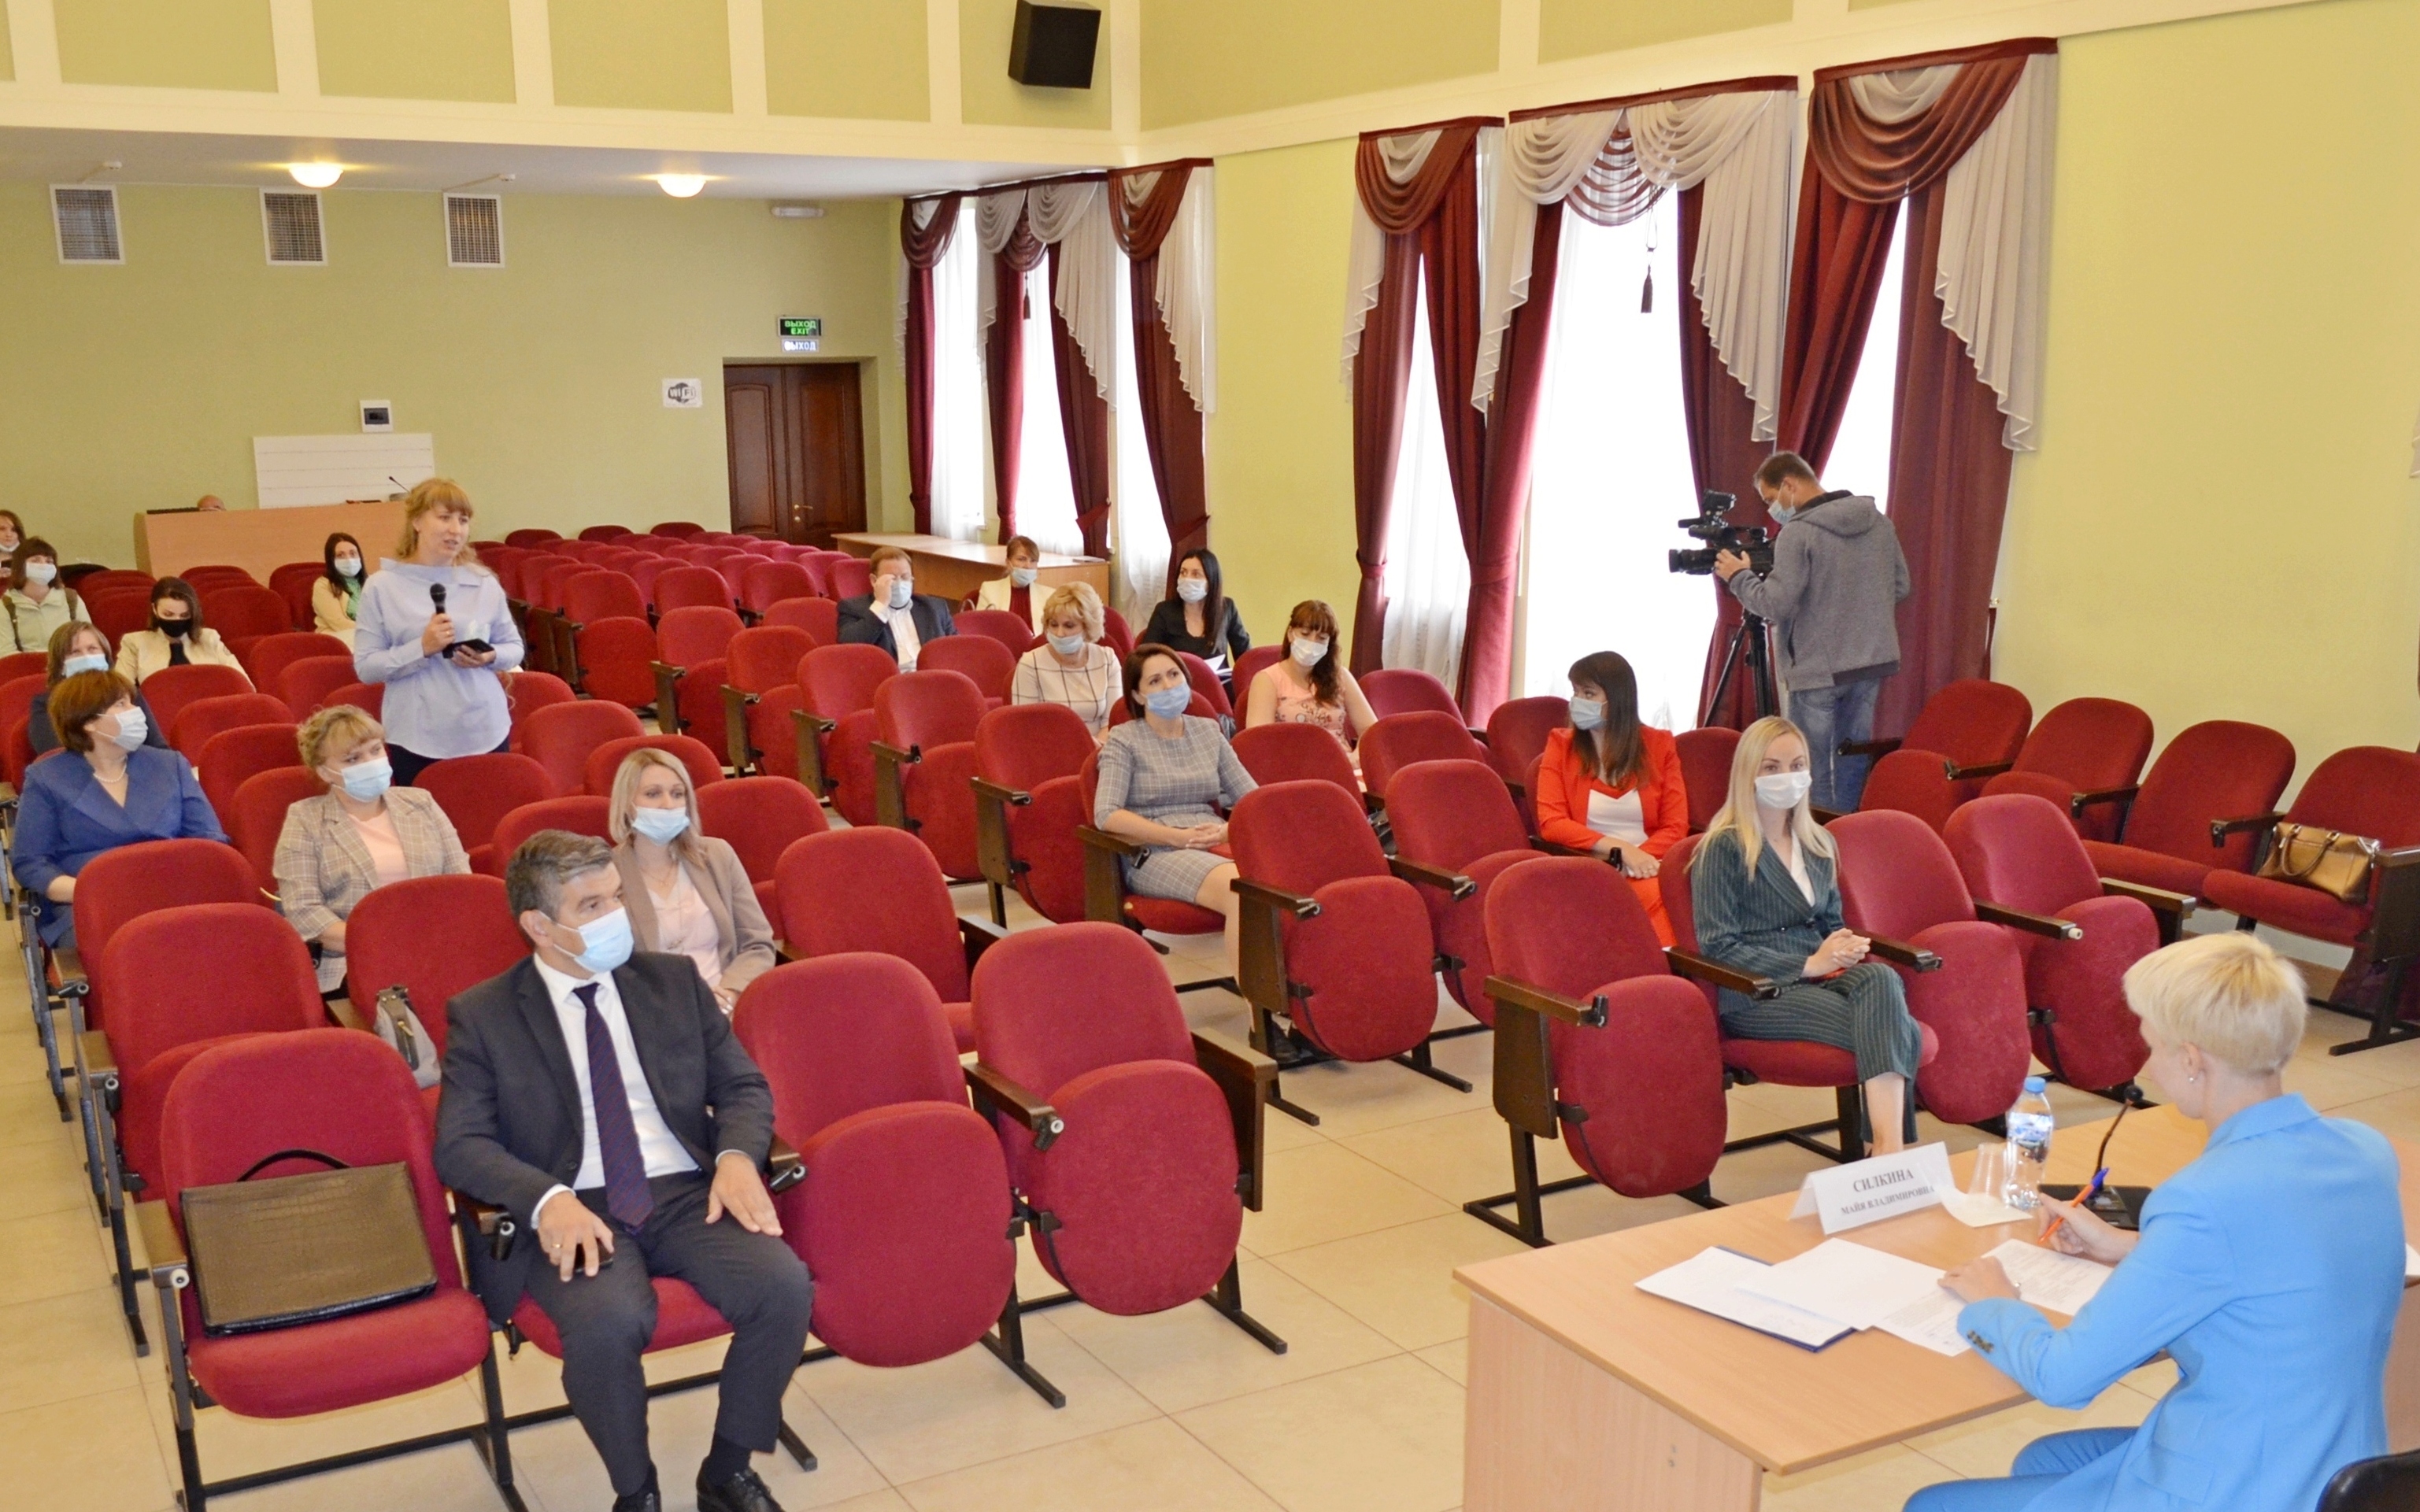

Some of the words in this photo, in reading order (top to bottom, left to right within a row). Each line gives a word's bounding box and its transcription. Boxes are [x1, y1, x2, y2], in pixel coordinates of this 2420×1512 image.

[785, 320, 816, 329] ВЫХОД
[784, 340, 816, 350] ВЫХОД
[1853, 1169, 1914, 1192] СИЛКИНА
[1841, 1202, 1866, 1214] МАЙЯ
[1867, 1185, 1934, 1208] ВЛАДИМИРОВНА
